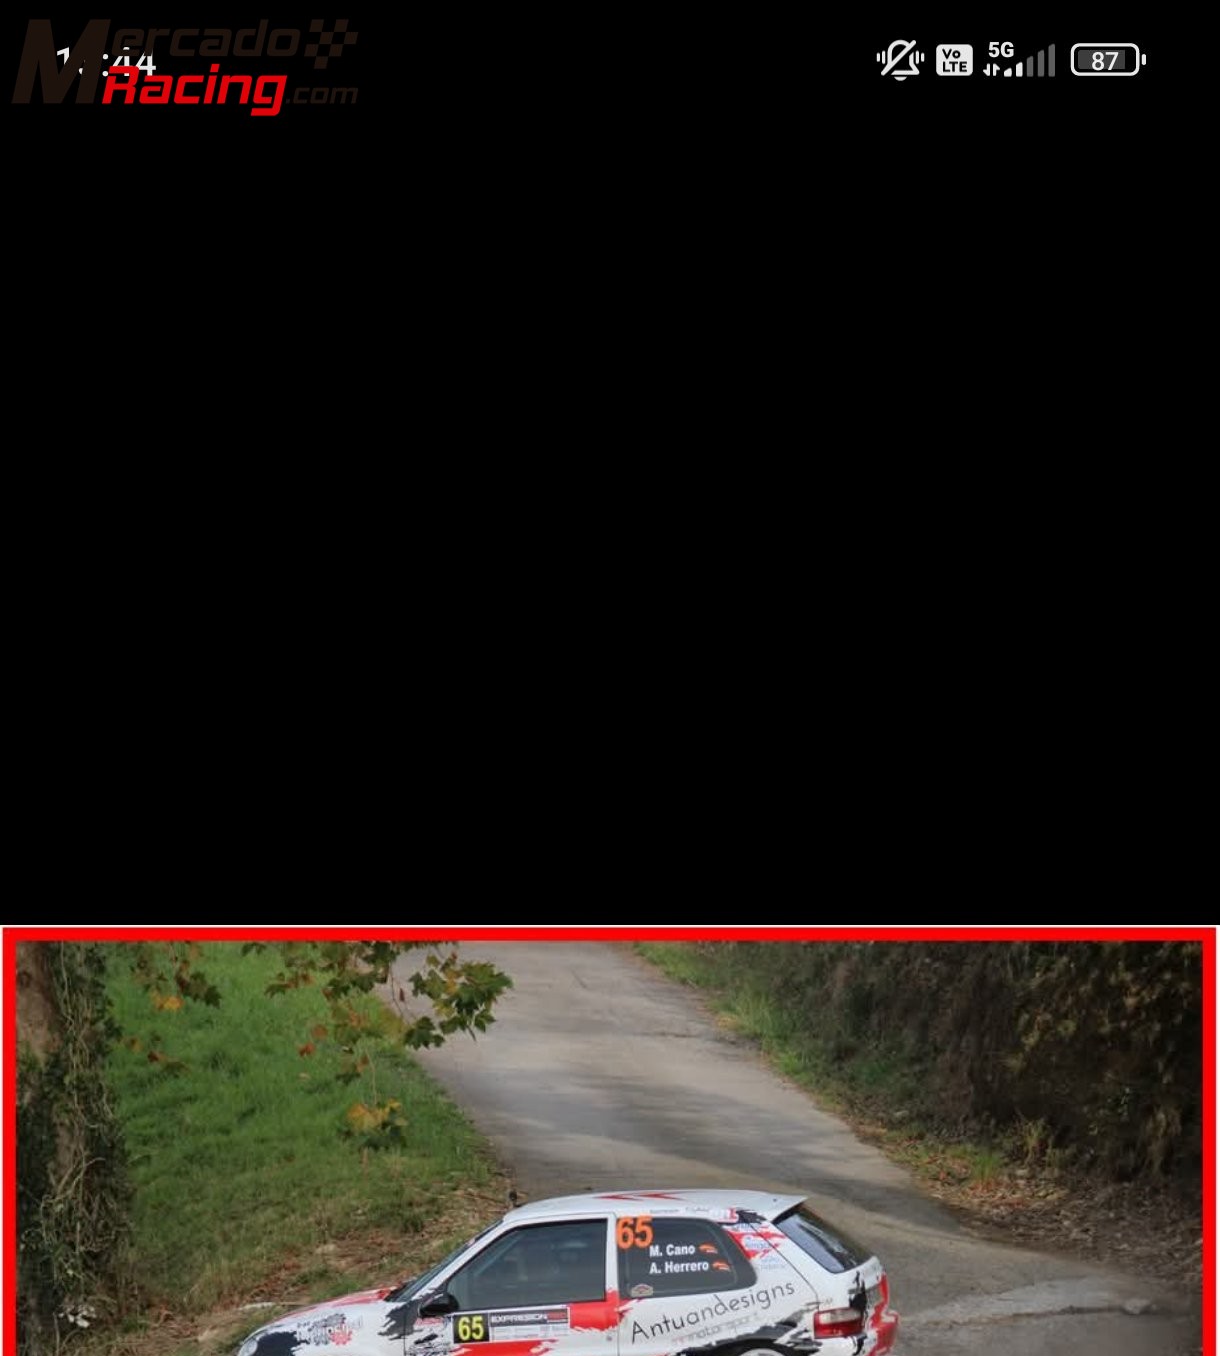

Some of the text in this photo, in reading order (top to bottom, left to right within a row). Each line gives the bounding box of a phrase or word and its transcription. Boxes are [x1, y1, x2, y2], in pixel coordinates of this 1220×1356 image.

[616, 1215, 654, 1250] 65
[649, 1244, 696, 1258] M. Cano
[649, 1261, 709, 1275] A. Herrero
[631, 1281, 796, 1345] Antuandesigns
[458, 1315, 485, 1341] 65
